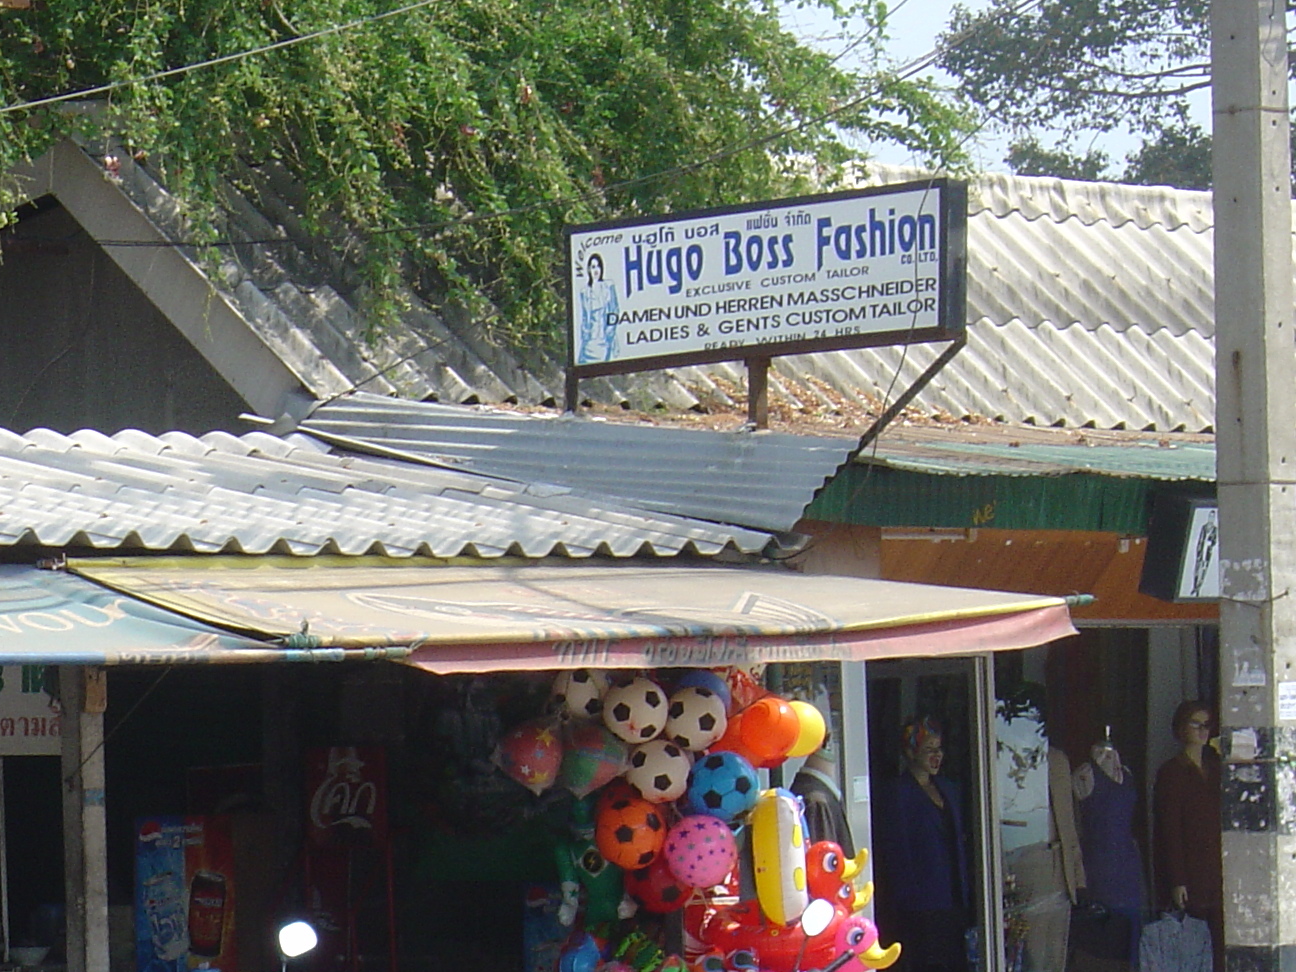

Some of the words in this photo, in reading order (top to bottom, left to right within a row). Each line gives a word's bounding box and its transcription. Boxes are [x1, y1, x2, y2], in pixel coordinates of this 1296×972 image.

[684, 222, 720, 240] บอส
[785, 208, 812, 227] จำกัด
[575, 233, 623, 278] Welcome
[624, 244, 704, 299] Hugo
[723, 230, 794, 276] Boss
[817, 207, 936, 272] Fashion
[918, 251, 938, 263] LTD.
[686, 280, 752, 298] EXCLUSIVE
[760, 272, 816, 288] CUSTOM
[826, 265, 870, 280] TAILOR
[606, 306, 672, 327] DAMEN
[674, 302, 712, 320] UND
[715, 294, 784, 315] HERREN
[787, 277, 937, 307] MASSCHNEIDER
[626, 325, 690, 345] LADIES
[696, 322, 711, 338] &
[718, 314, 781, 334] GENTS
[785, 306, 866, 327] CUSTOM
[869, 298, 937, 319] TAILOR
[704, 338, 745, 351] READY
[835, 326, 861, 337] HRS
